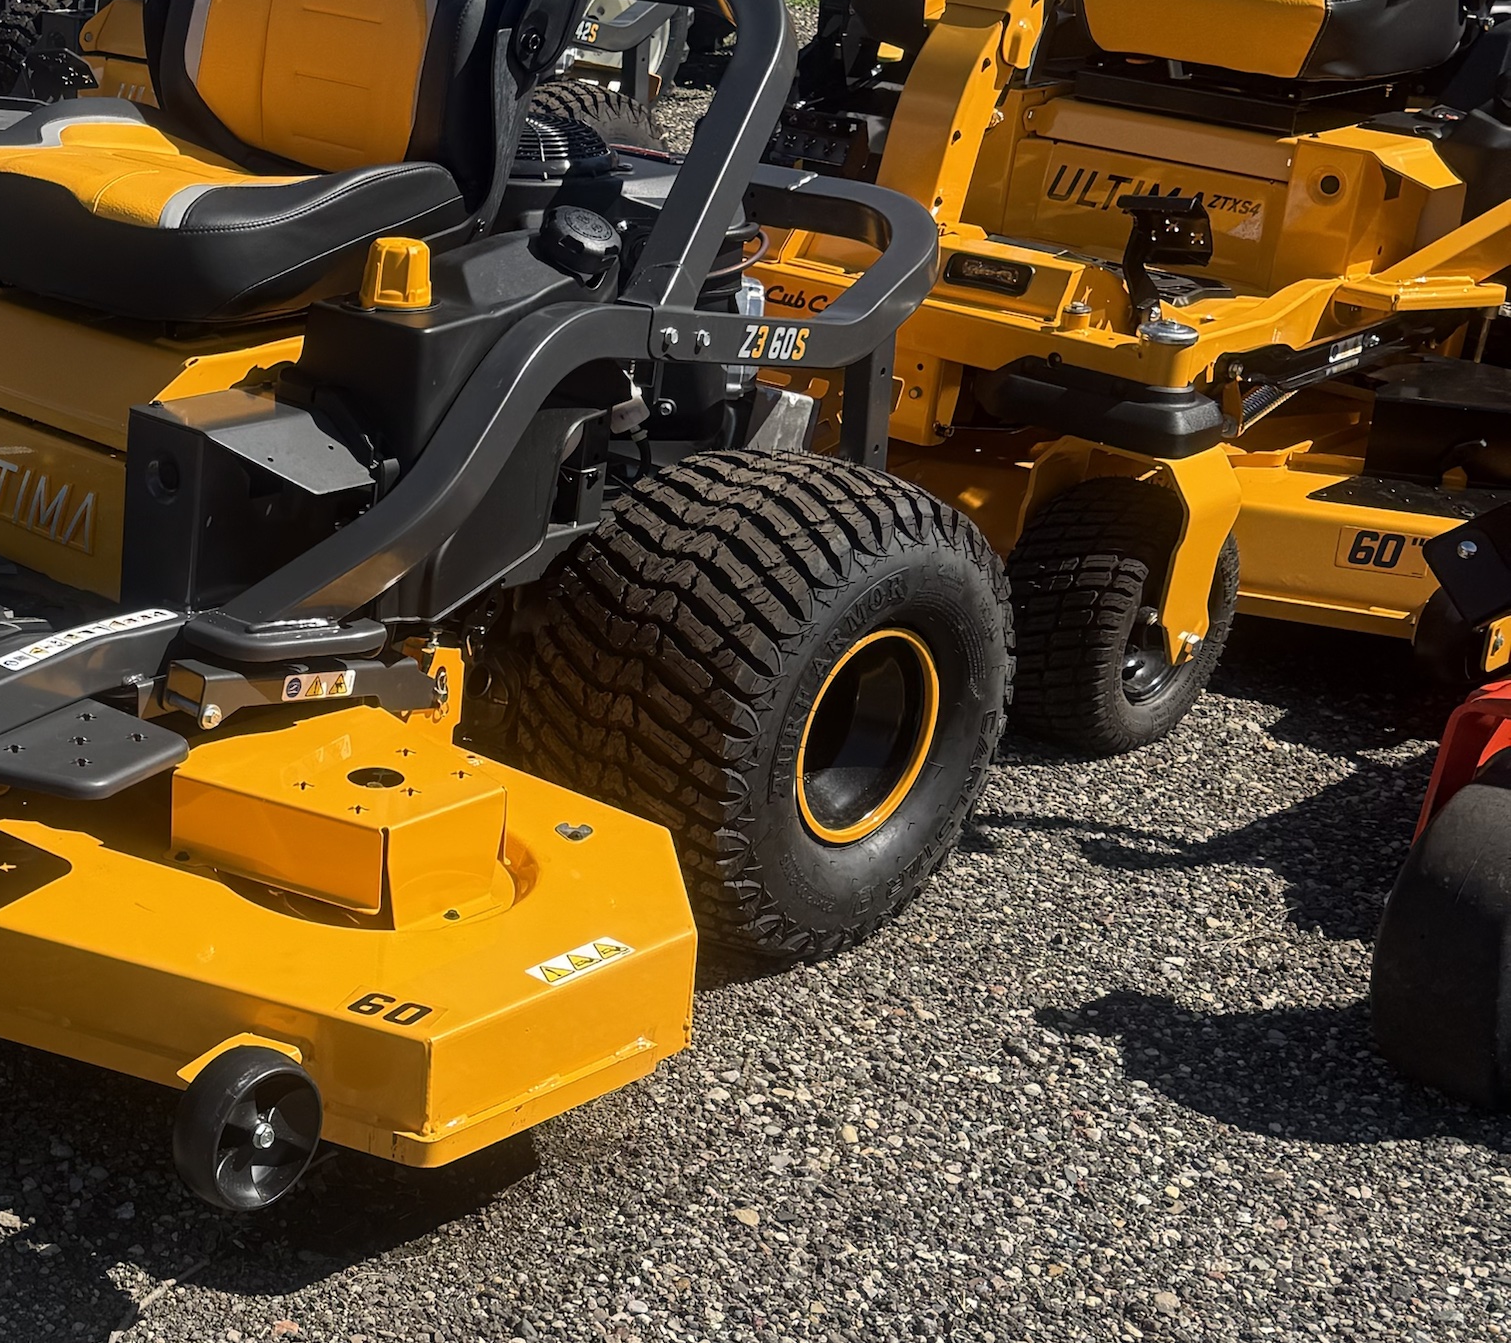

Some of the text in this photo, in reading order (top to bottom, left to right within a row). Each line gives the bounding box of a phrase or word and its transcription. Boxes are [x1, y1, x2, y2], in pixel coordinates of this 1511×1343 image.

[575, 20, 600, 44] 42S
[1207, 194, 1263, 217] ZTXS4
[765, 285, 806, 308] Cub
[737, 324, 810, 361] Z3 60S
[1348, 529, 1426, 569] 60"
[811, 573, 908, 679] ARMOR
[347, 992, 433, 1026] 60
